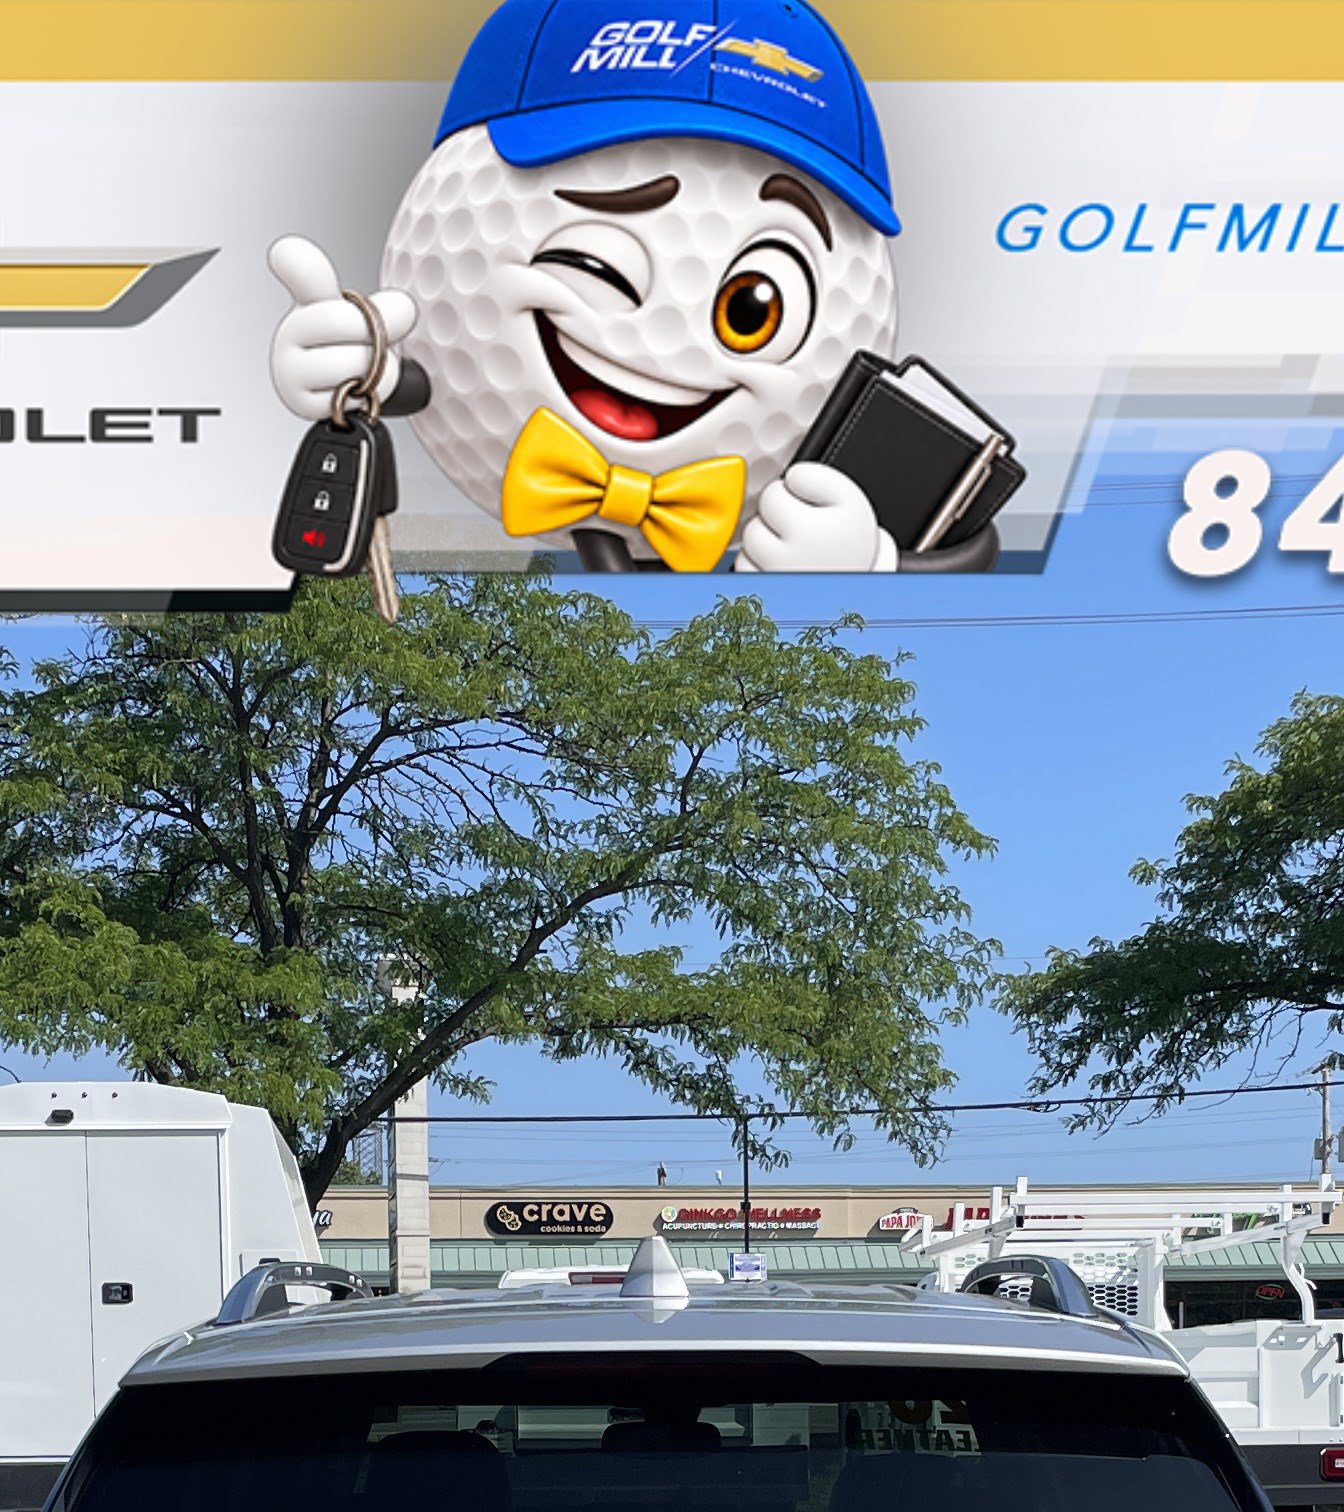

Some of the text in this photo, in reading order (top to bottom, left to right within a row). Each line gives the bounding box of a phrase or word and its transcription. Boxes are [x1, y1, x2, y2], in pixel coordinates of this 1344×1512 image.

[522, 1203, 607, 1222] crave
[678, 1208, 737, 1221] GINKGO
[540, 1224, 575, 1233] cookies
[584, 1224, 607, 1233] soda
[881, 1215, 903, 1229] PAPA
